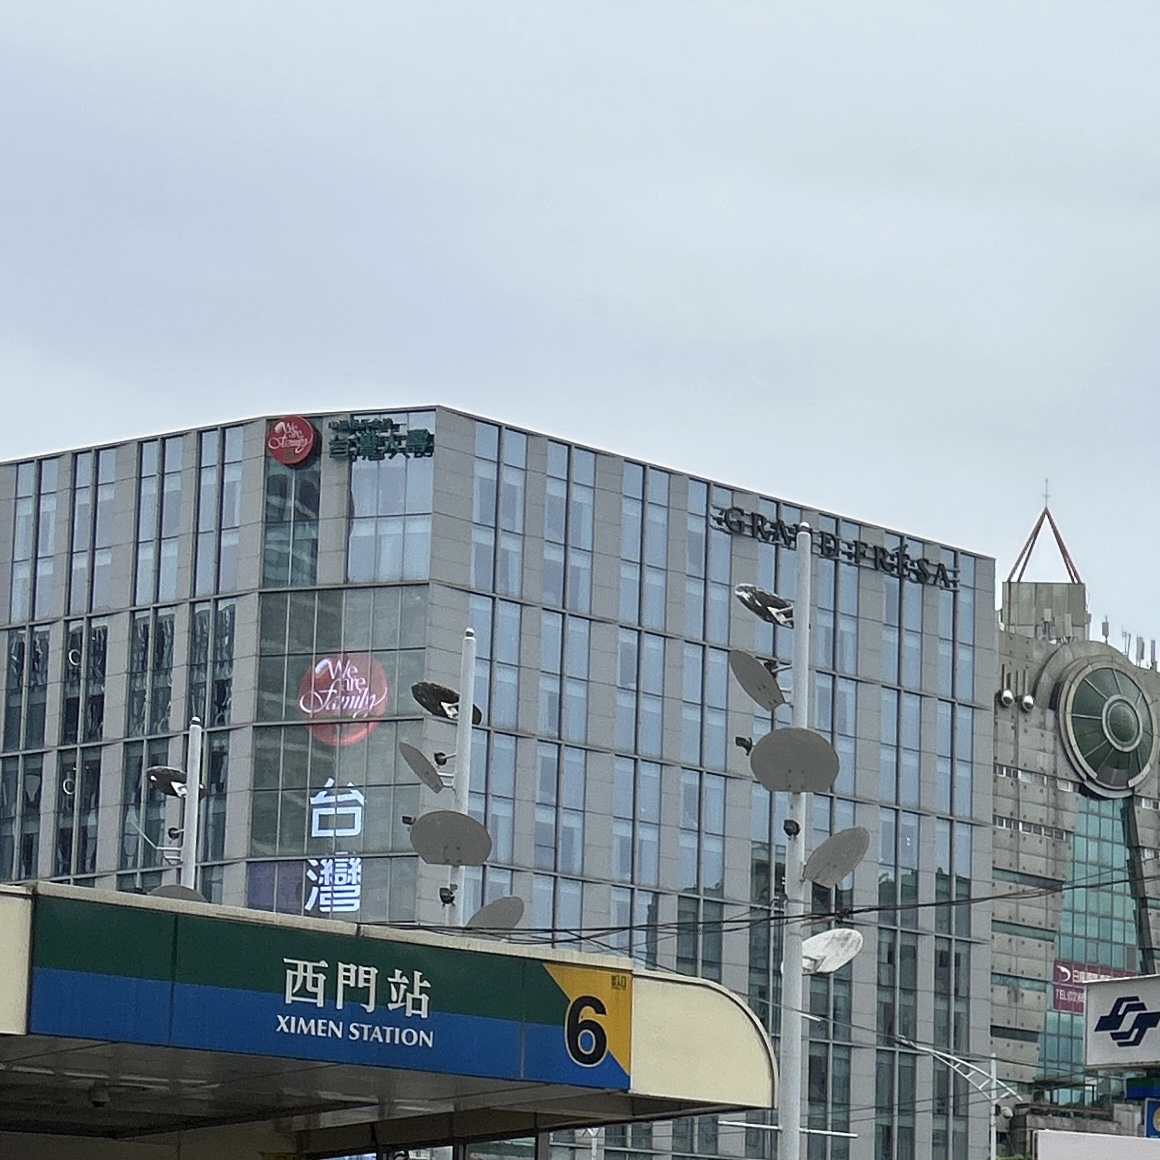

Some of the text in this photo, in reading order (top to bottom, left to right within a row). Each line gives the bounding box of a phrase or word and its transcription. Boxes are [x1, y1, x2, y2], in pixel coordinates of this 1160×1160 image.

[315, 658, 359, 680] We
[305, 778, 364, 914] 台灣
[282, 957, 432, 1019] 西門站
[276, 1014, 434, 1048] XIMEN STATION
[565, 994, 608, 1068] 6
